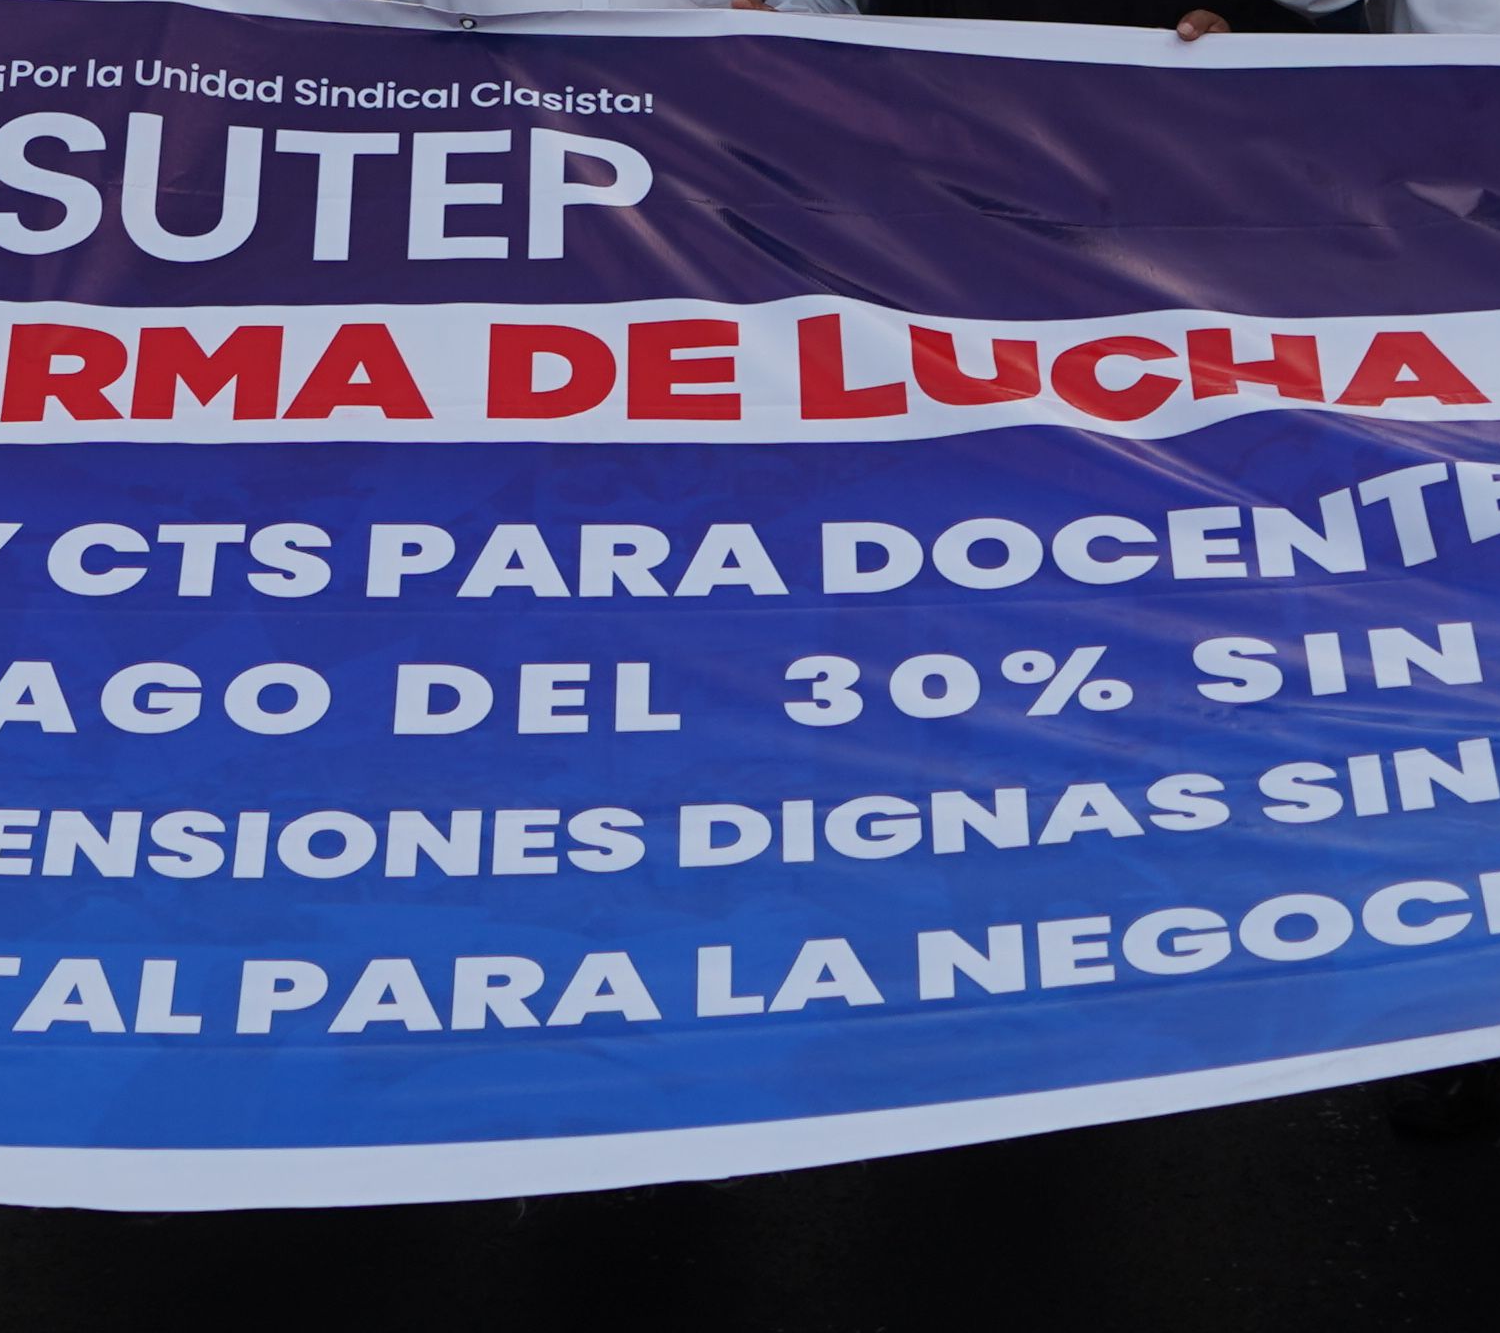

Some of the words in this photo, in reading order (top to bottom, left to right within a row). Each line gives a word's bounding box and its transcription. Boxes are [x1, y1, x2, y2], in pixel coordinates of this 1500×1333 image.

[86, 58, 124, 90] la
[134, 59, 284, 104] Unidad
[295, 77, 460, 110] Sindical
[469, 81, 655, 115] Clasista!
[487, 318, 741, 420] DE
[799, 313, 1491, 422] LUCHA
[45, 521, 334, 599] CTS
[364, 523, 790, 599] PARA
[393, 661, 681, 735] DEL
[783, 645, 1134, 728] 30%
[1193, 621, 1483, 704] SIN
[679, 772, 1230, 869] DIGNAS
[1257, 737, 1500, 825] SIN
[235, 949, 662, 1035] PARA
[695, 936, 885, 1020] LA
